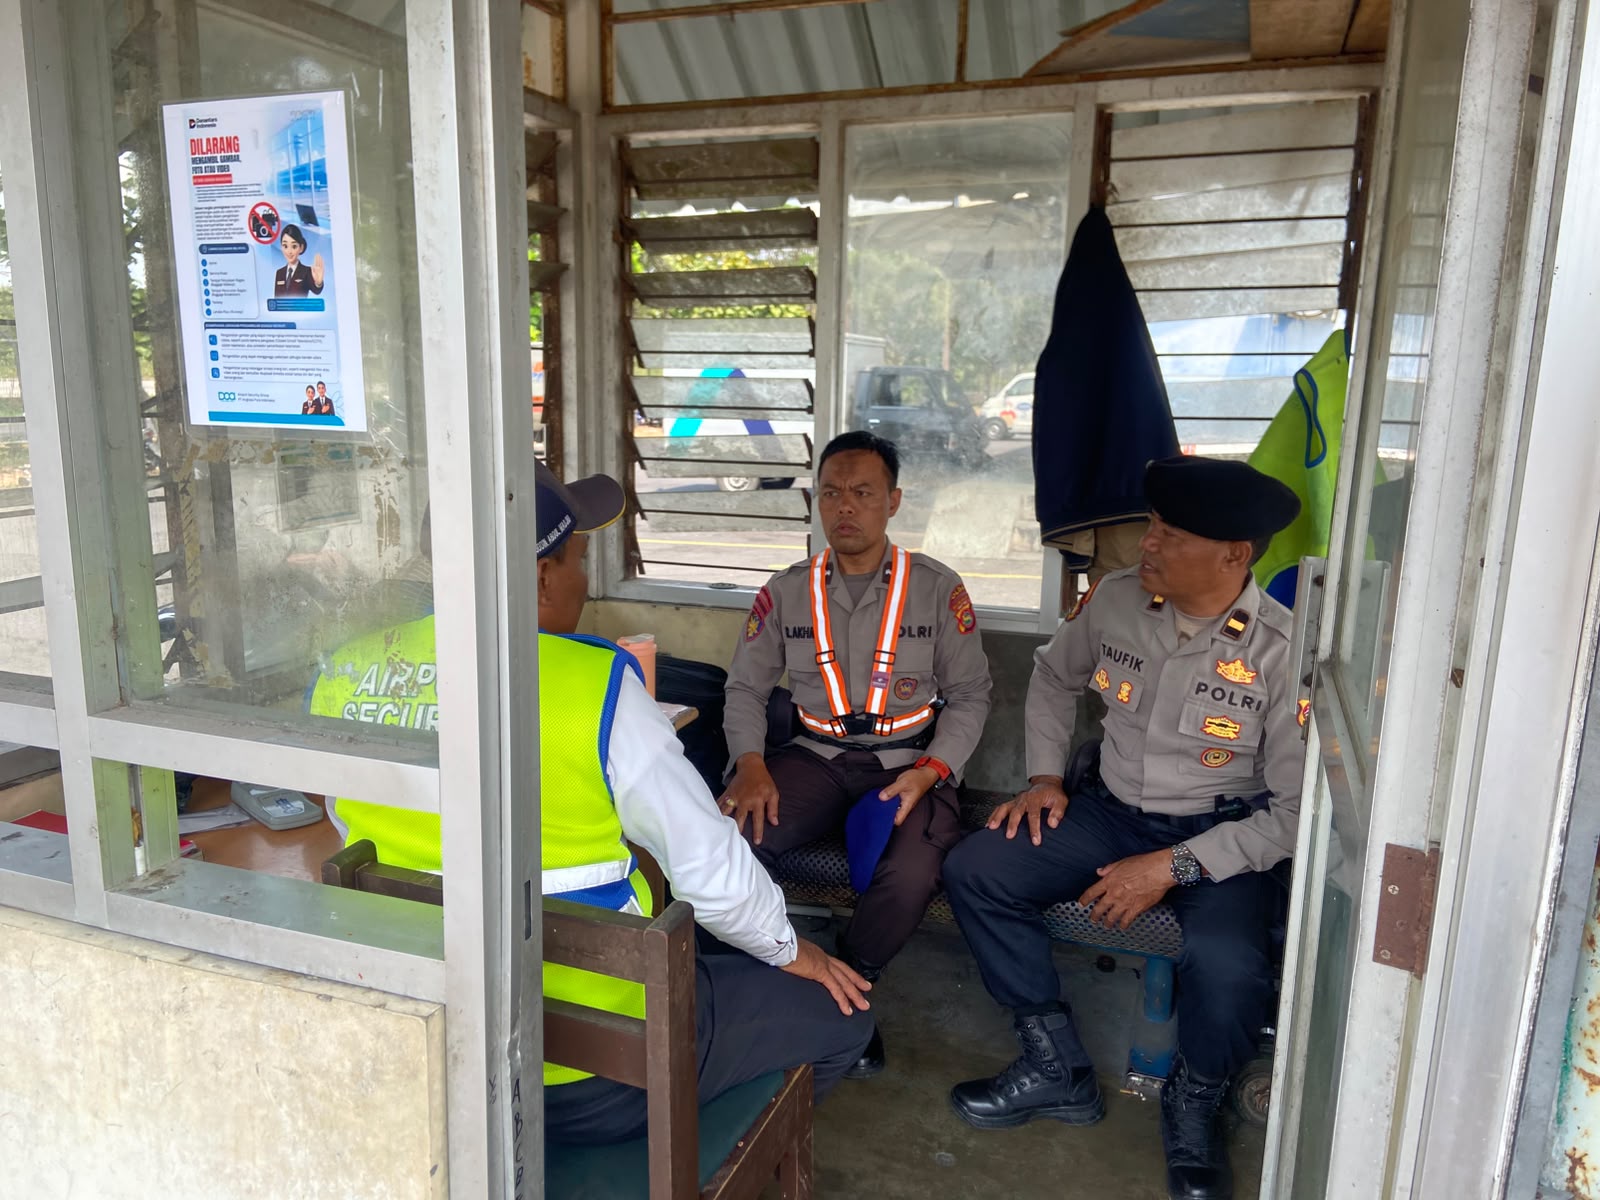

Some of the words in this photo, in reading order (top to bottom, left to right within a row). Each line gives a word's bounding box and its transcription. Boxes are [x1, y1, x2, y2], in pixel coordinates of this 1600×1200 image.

[190, 135, 240, 155] DILARANG
[192, 166, 203, 174] FOTO
[217, 164, 230, 173] VIDEO
[897, 625, 932, 639] OLRI
[1101, 643, 1144, 673] TAUFIK
[353, 662, 438, 698] AIRP
[1195, 681, 1263, 713] POLRI
[341, 701, 438, 731] SECUR
